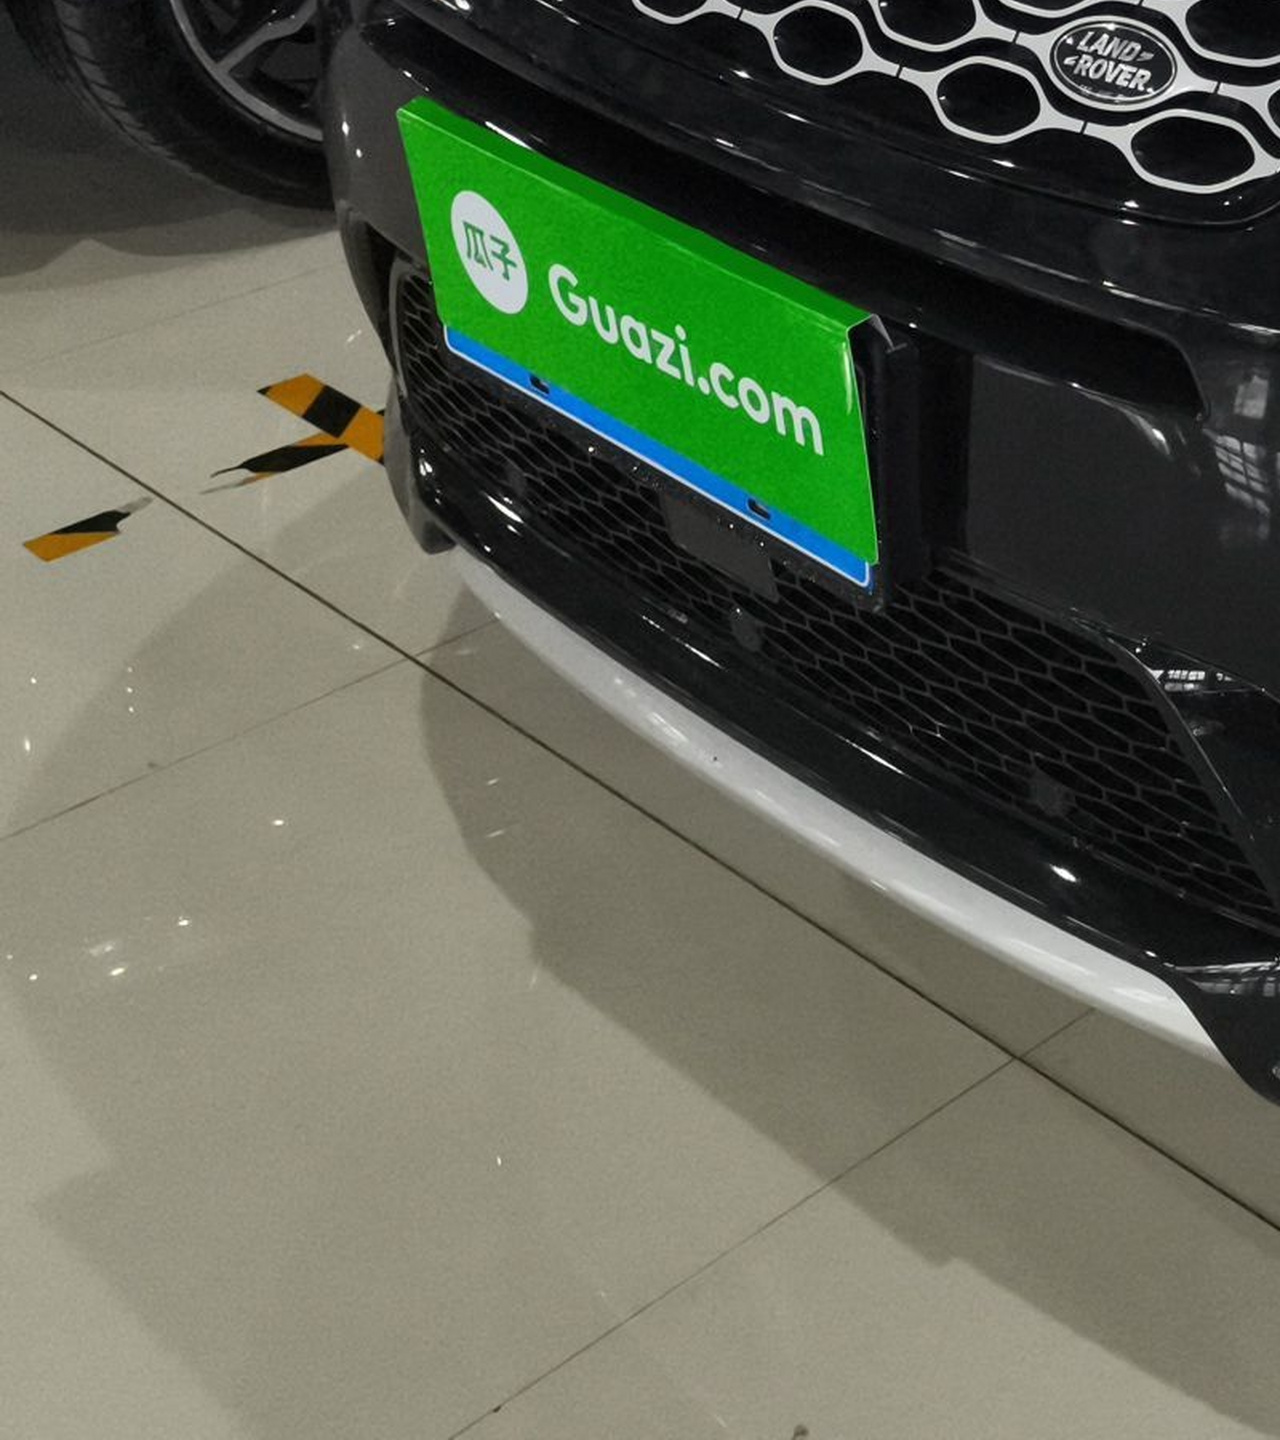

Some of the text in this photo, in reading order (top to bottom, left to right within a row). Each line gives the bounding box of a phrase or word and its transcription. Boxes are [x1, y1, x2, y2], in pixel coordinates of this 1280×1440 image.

[1077, 31, 1142, 61] LAND
[1073, 54, 1152, 91] ROVER
[463, 221, 824, 456] 瓜子 Guazi.com
